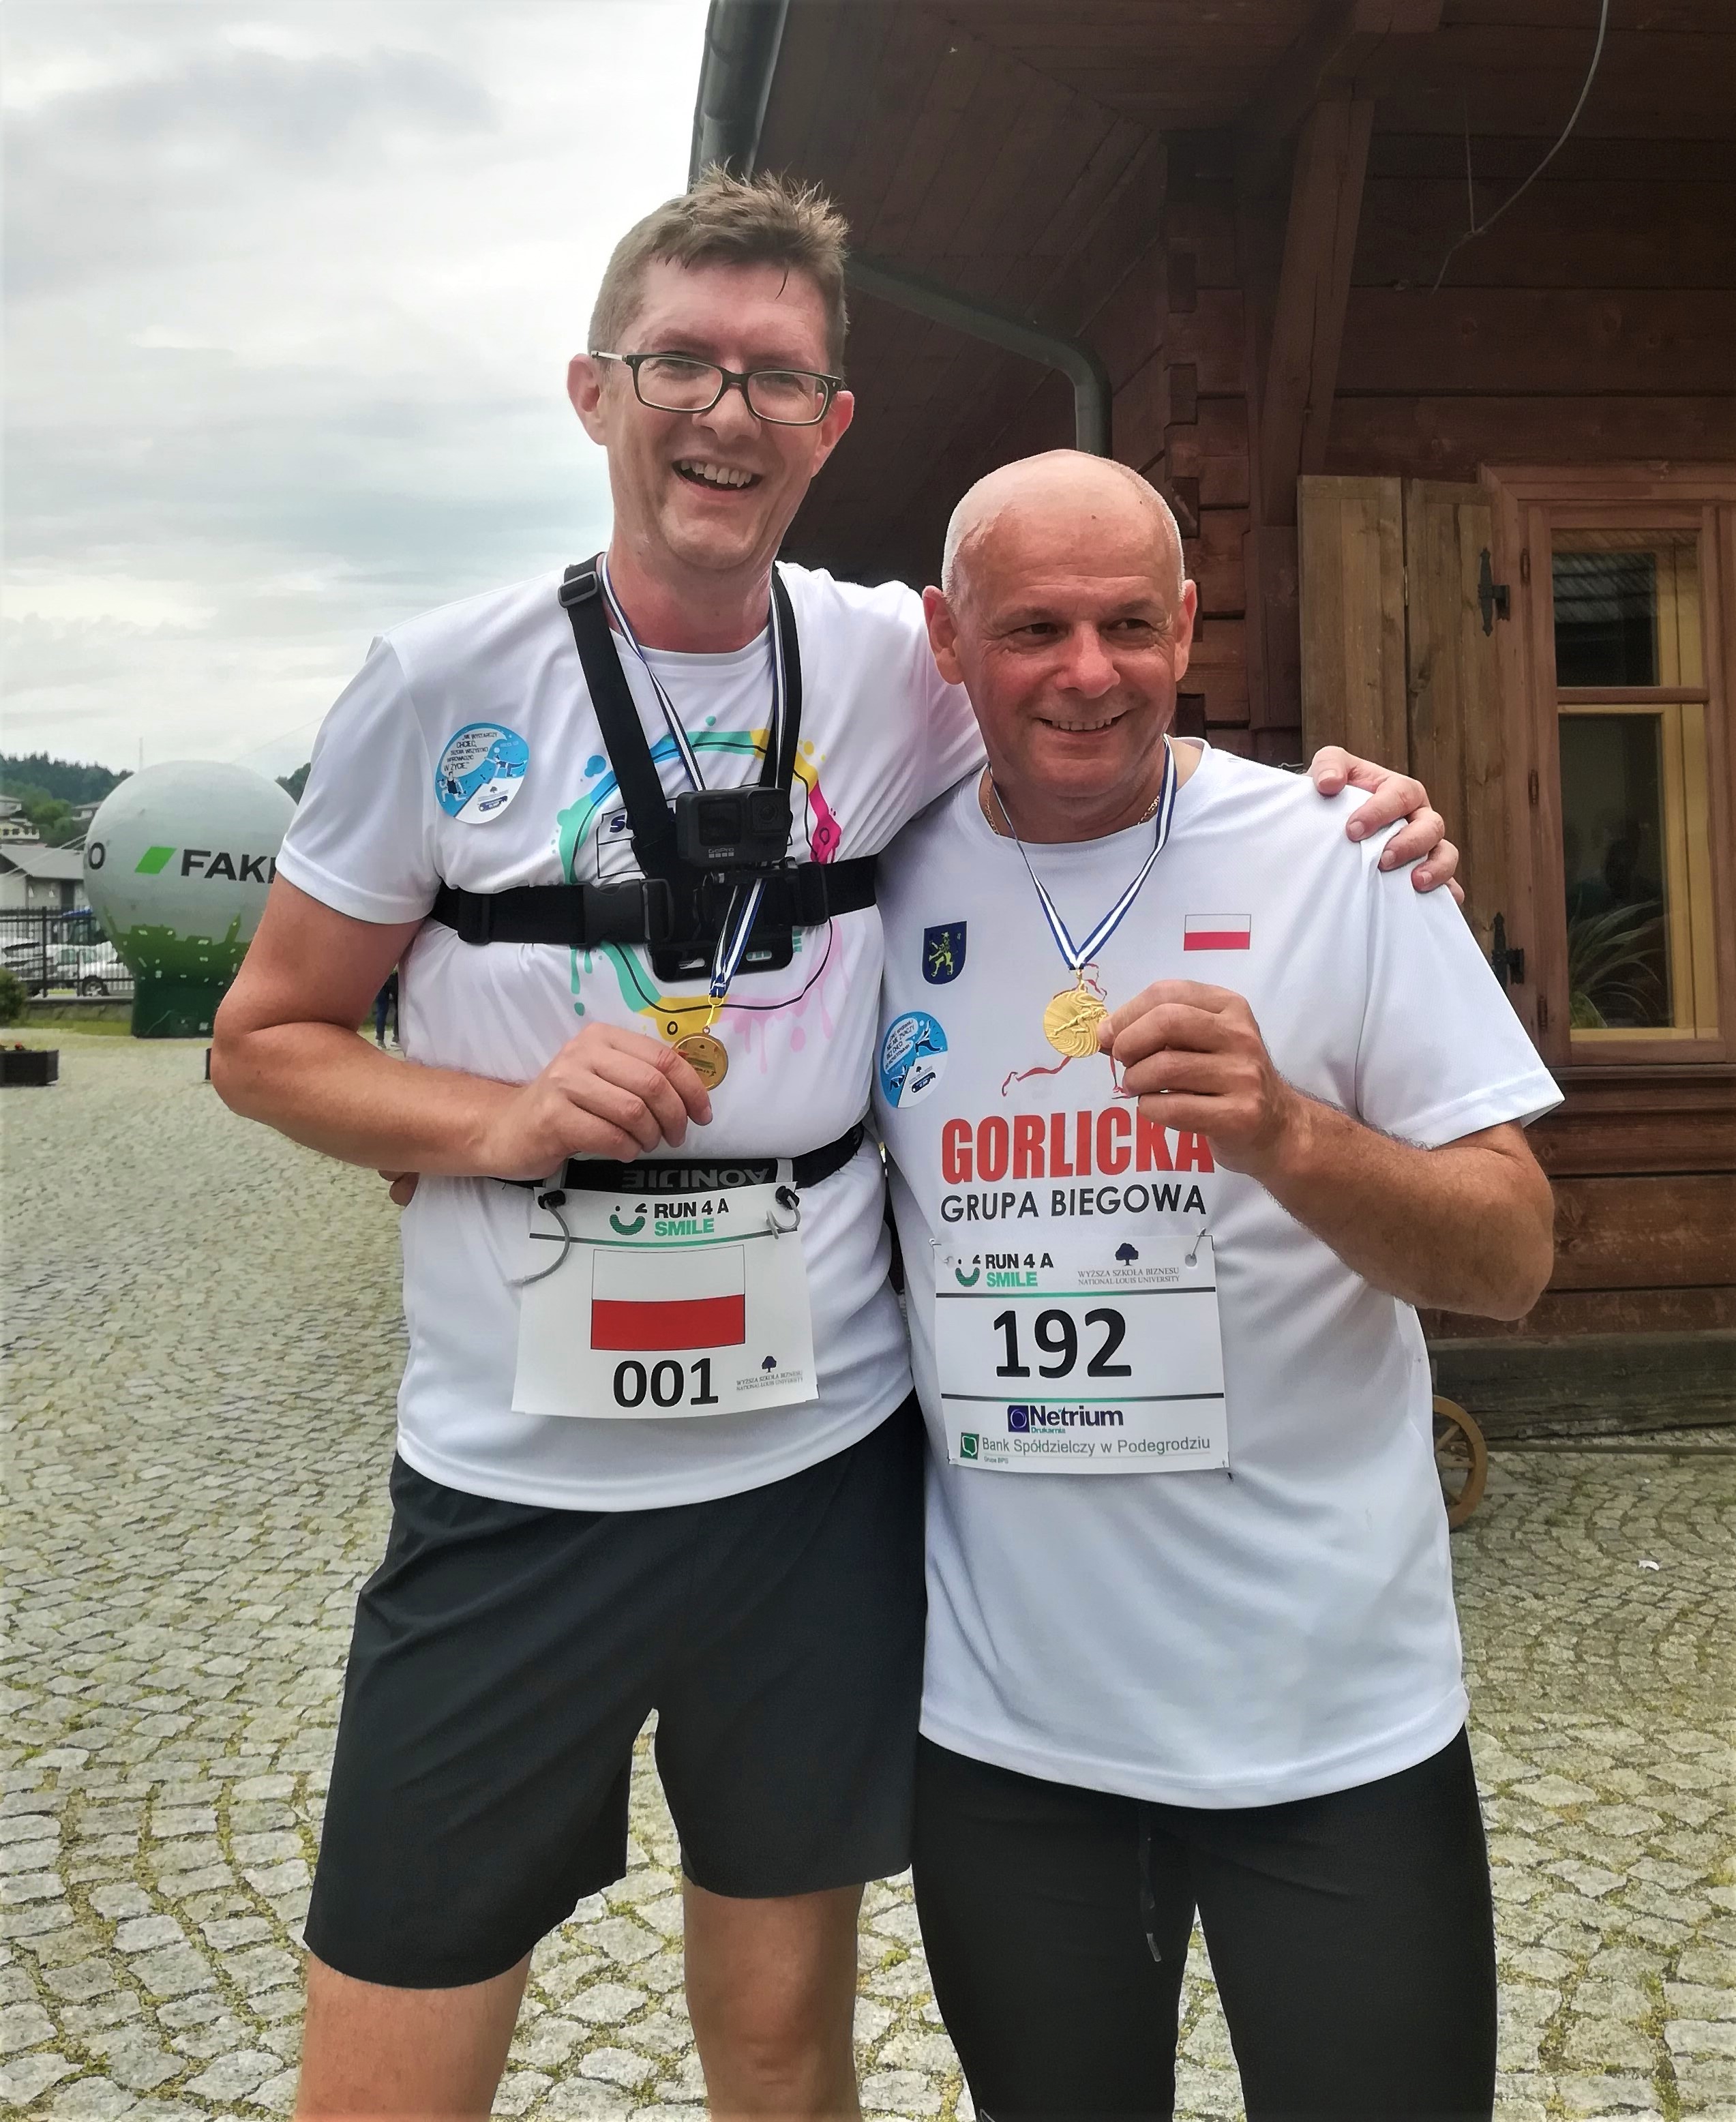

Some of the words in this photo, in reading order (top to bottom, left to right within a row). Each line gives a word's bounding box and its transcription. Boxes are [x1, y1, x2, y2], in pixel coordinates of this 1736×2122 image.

[181, 849, 277, 884] FAK
[942, 1106, 1215, 1185] GORLICKA
[654, 1201, 697, 1219] RUN
[701, 1199, 713, 1215] 4
[717, 1198, 729, 1214] A
[941, 1191, 1040, 1223] GRUPA
[1051, 1183, 1206, 1217] BIEGOWA
[654, 1218, 715, 1237] SMILE
[985, 1253, 1019, 1269] RUN
[1023, 1253, 1036, 1268] 4
[1040, 1253, 1054, 1268] A
[986, 1271, 1038, 1287] SMILE
[1077, 1270, 1111, 1278] WYŻSZA
[1112, 1268, 1143, 1276] SZKOŁA
[1146, 1267, 1180, 1276] BIZNESU
[1137, 1275, 1180, 1283] UNIVERSITY
[993, 1308, 1132, 1378] 192
[614, 1358, 719, 1408] 001
[1030, 1405, 1124, 1426] Netrium
[982, 1437, 1010, 1452] Bank
[1013, 1439, 1096, 1457] Spółdzielczy
[1100, 1442, 1113, 1453] w
[1118, 1435, 1211, 1455] Podegrodziu
